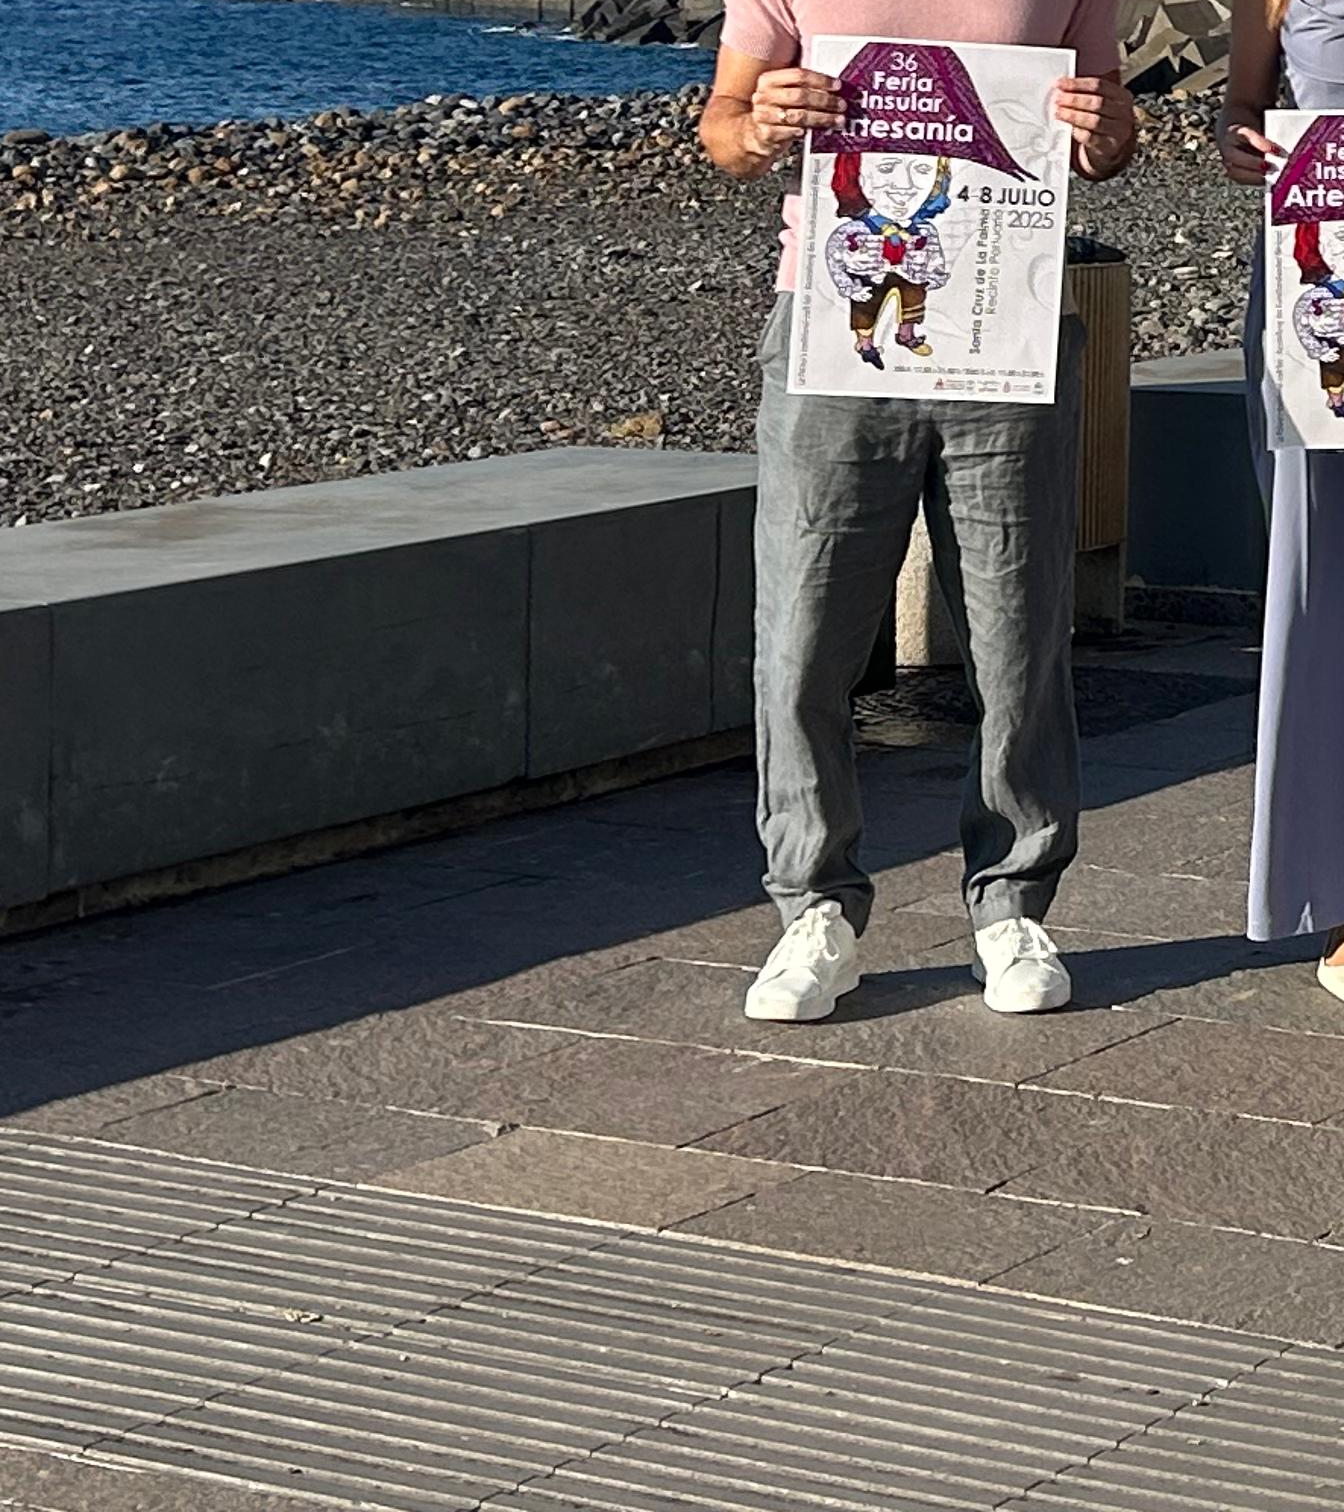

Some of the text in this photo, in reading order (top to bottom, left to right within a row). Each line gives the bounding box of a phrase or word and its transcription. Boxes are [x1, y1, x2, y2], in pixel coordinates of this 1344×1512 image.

[890, 51, 919, 71] 36
[873, 71, 933, 91] Feria
[861, 91, 944, 113] Insular
[997, 188, 1055, 206] JULIO
[1008, 210, 1054, 229] 2025
[976, 251, 987, 264] La
[975, 268, 986, 284] de
